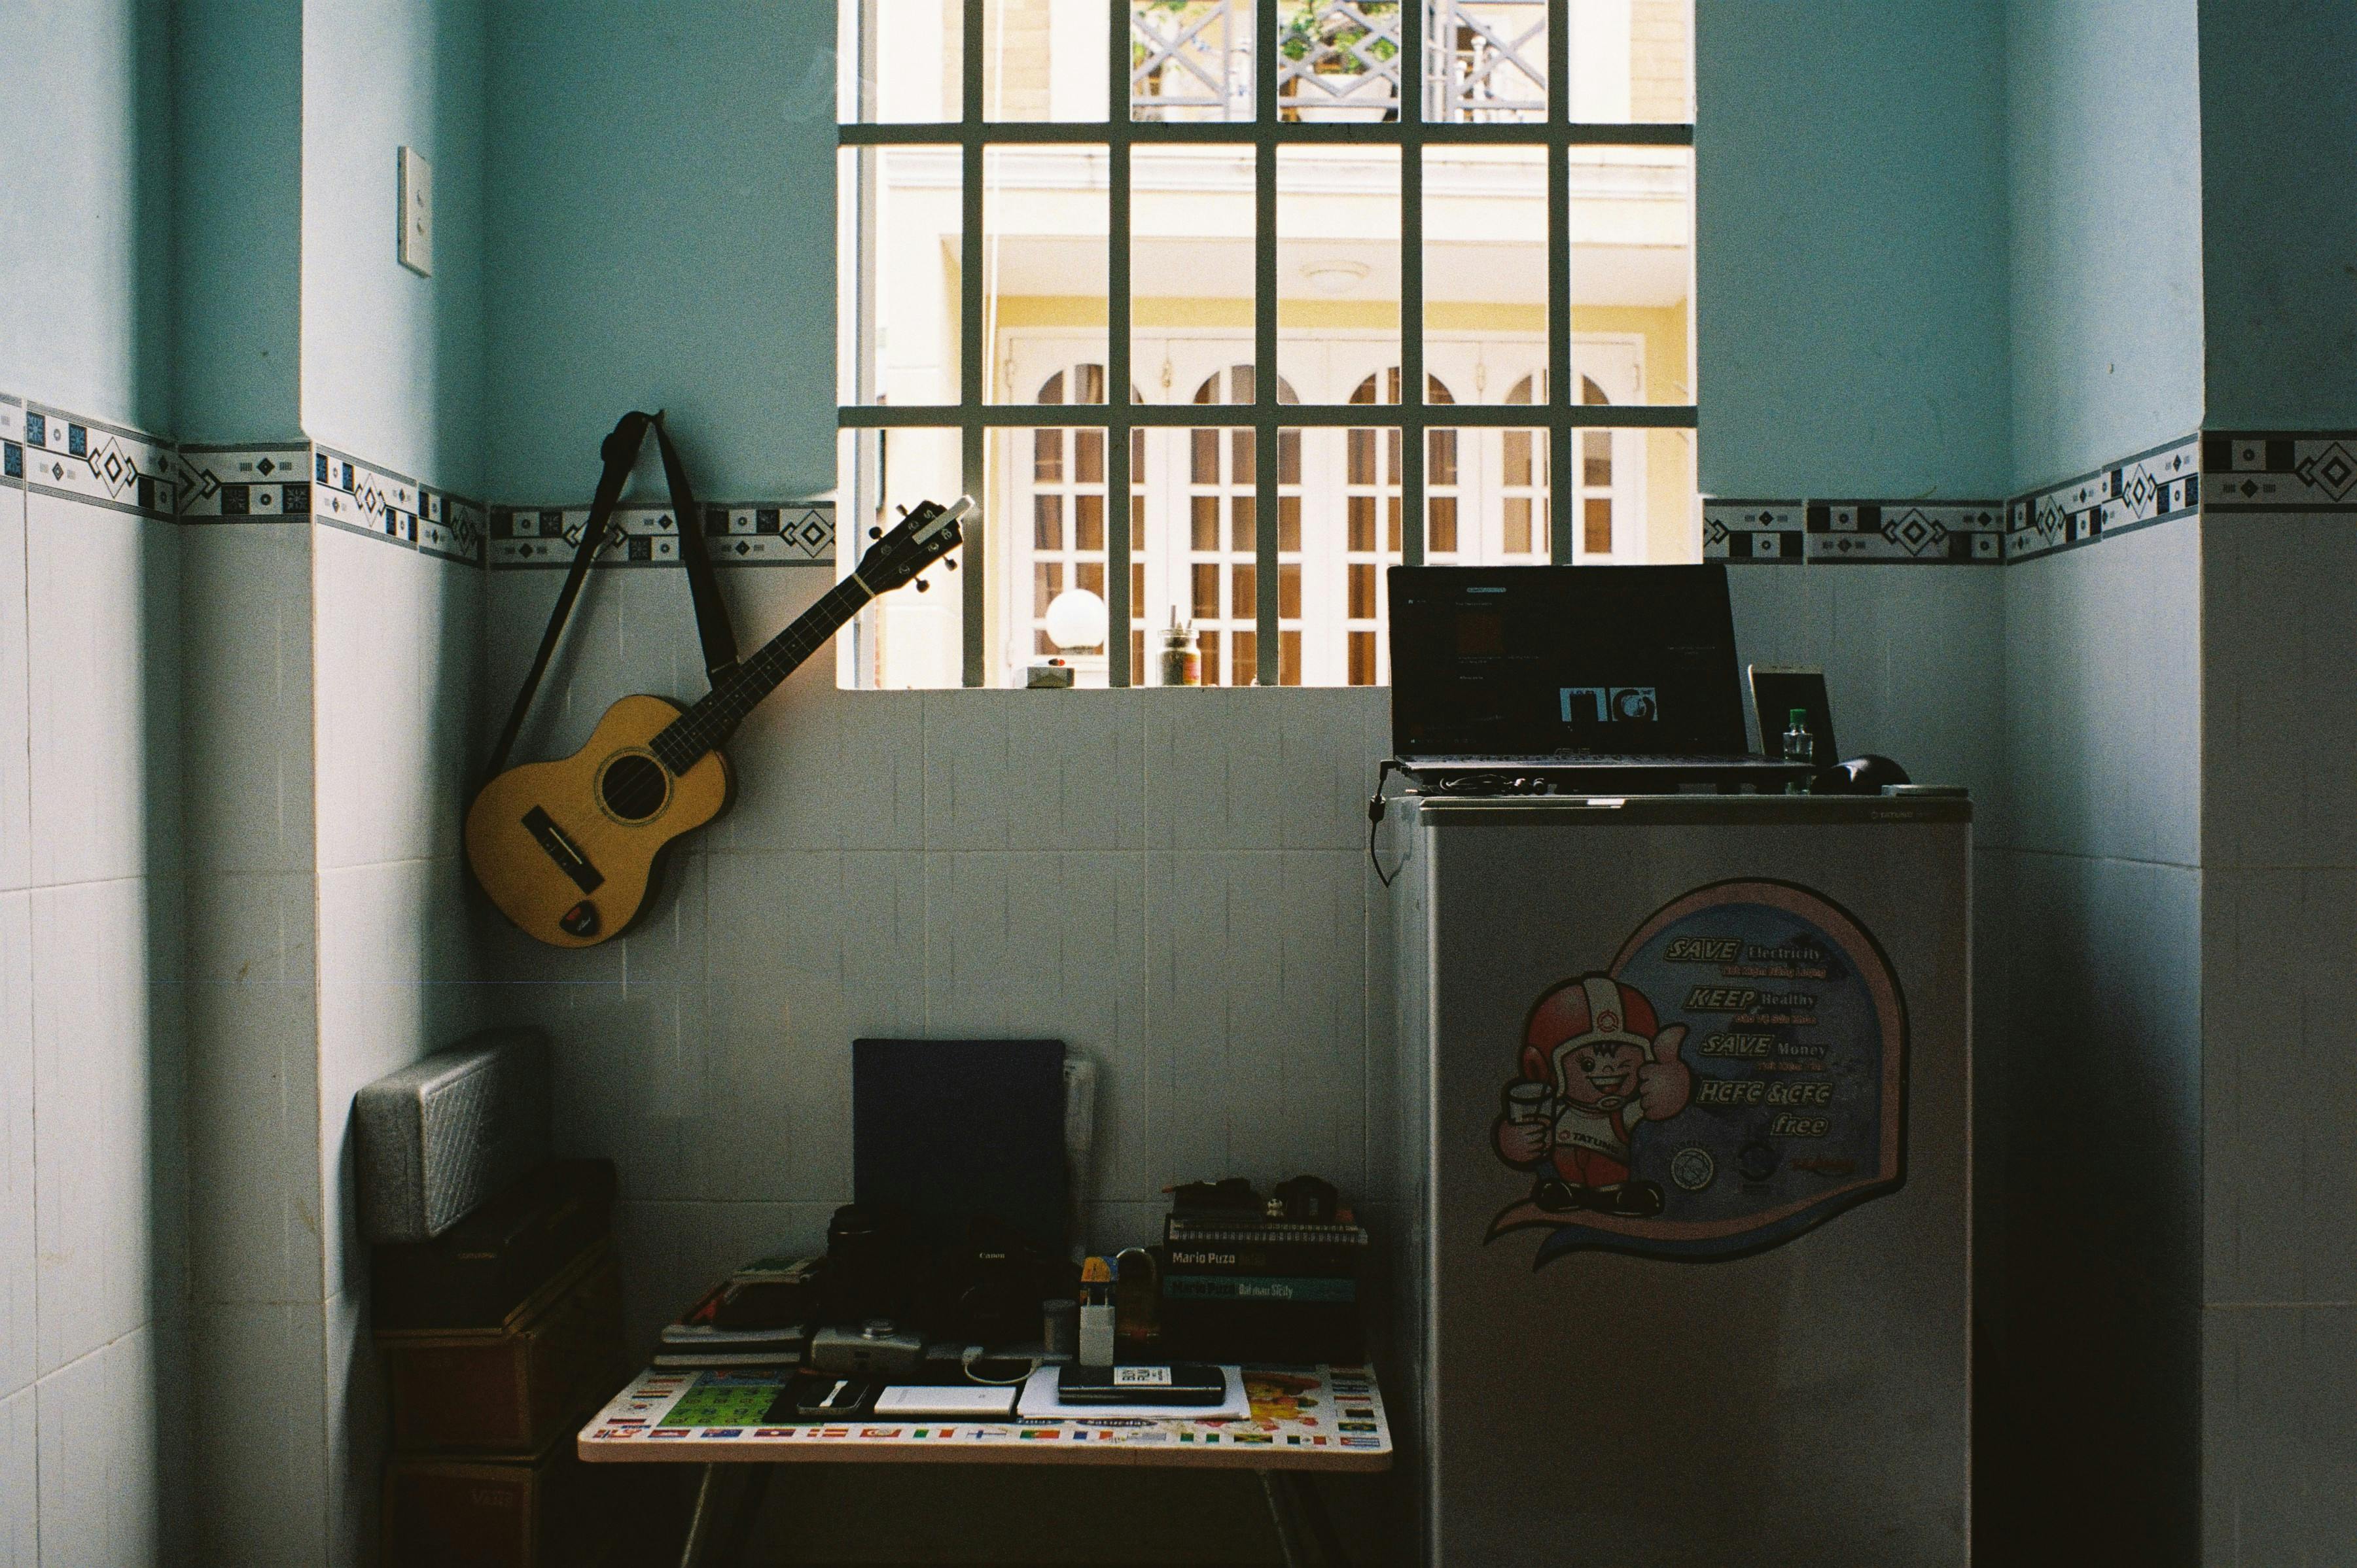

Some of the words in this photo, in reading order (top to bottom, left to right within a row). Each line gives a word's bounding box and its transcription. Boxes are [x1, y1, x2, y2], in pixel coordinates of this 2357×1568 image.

[1667, 939, 1739, 960] SAVE
[1748, 946, 1822, 962] Electricity
[1688, 988, 1756, 1008] KEEP
[1760, 992, 1816, 1009] Healthy
[1701, 1035, 1772, 1055] SAVE
[1777, 1042, 1826, 1058] Money
[1699, 1082, 1763, 1104] HCFC
[1773, 1114, 1827, 1135] free
[1172, 1251, 1206, 1264] Mario
[1207, 1252, 1236, 1264] Puzo
[1172, 1281, 1205, 1295] Mario
[1207, 1282, 1235, 1295] Puzo
[1271, 1283, 1294, 1299] Sicily
